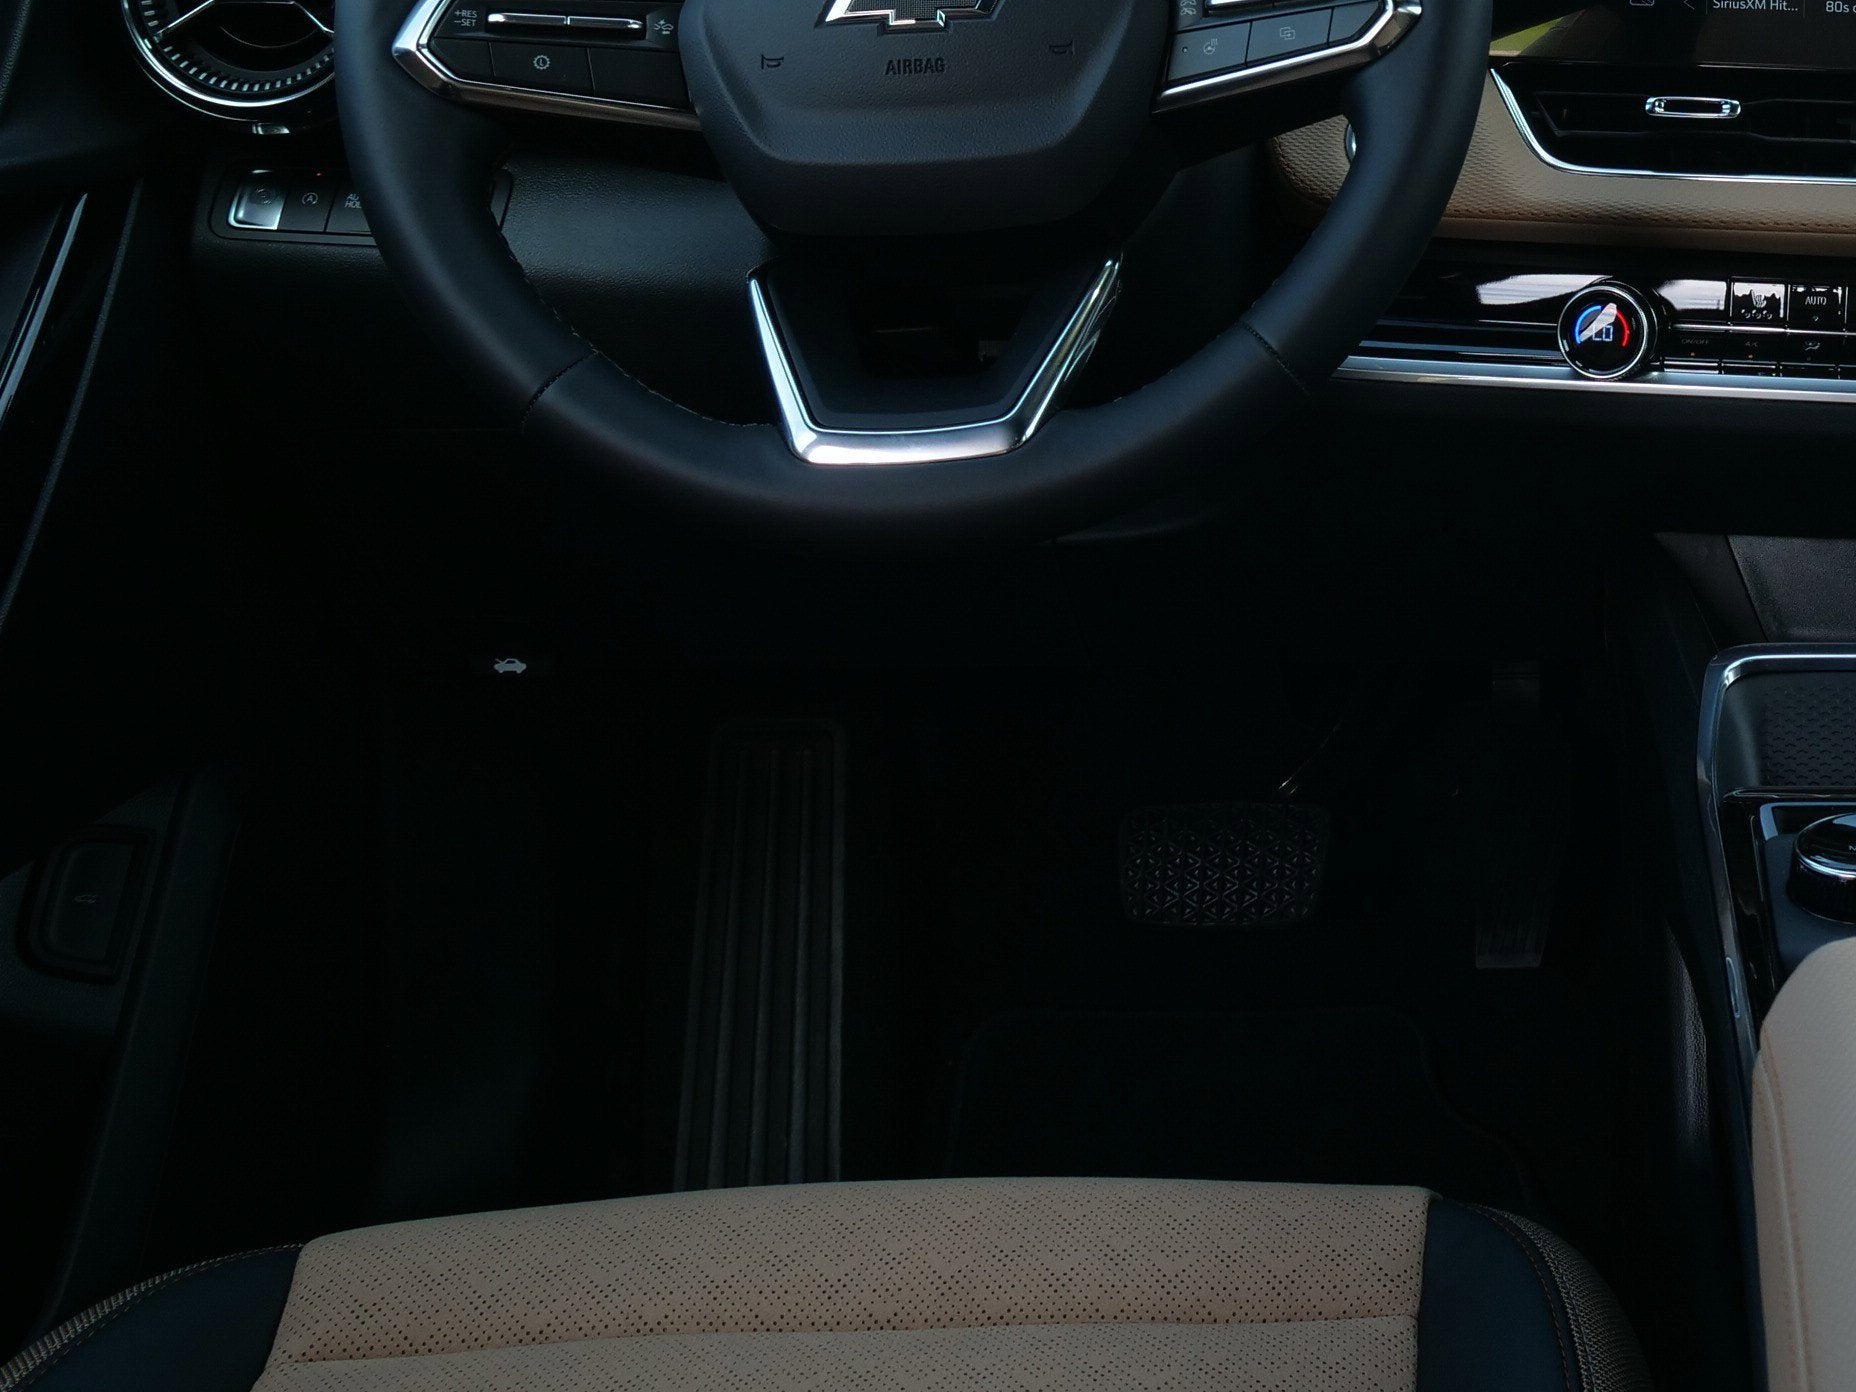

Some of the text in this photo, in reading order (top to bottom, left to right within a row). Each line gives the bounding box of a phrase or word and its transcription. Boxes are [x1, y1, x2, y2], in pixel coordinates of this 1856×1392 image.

[1769, 0, 1798, 11] Hit...
[1825, 2, 1850, 13] 80s
[885, 58, 946, 75] AIRBAG
[1804, 295, 1828, 306] AUTO
